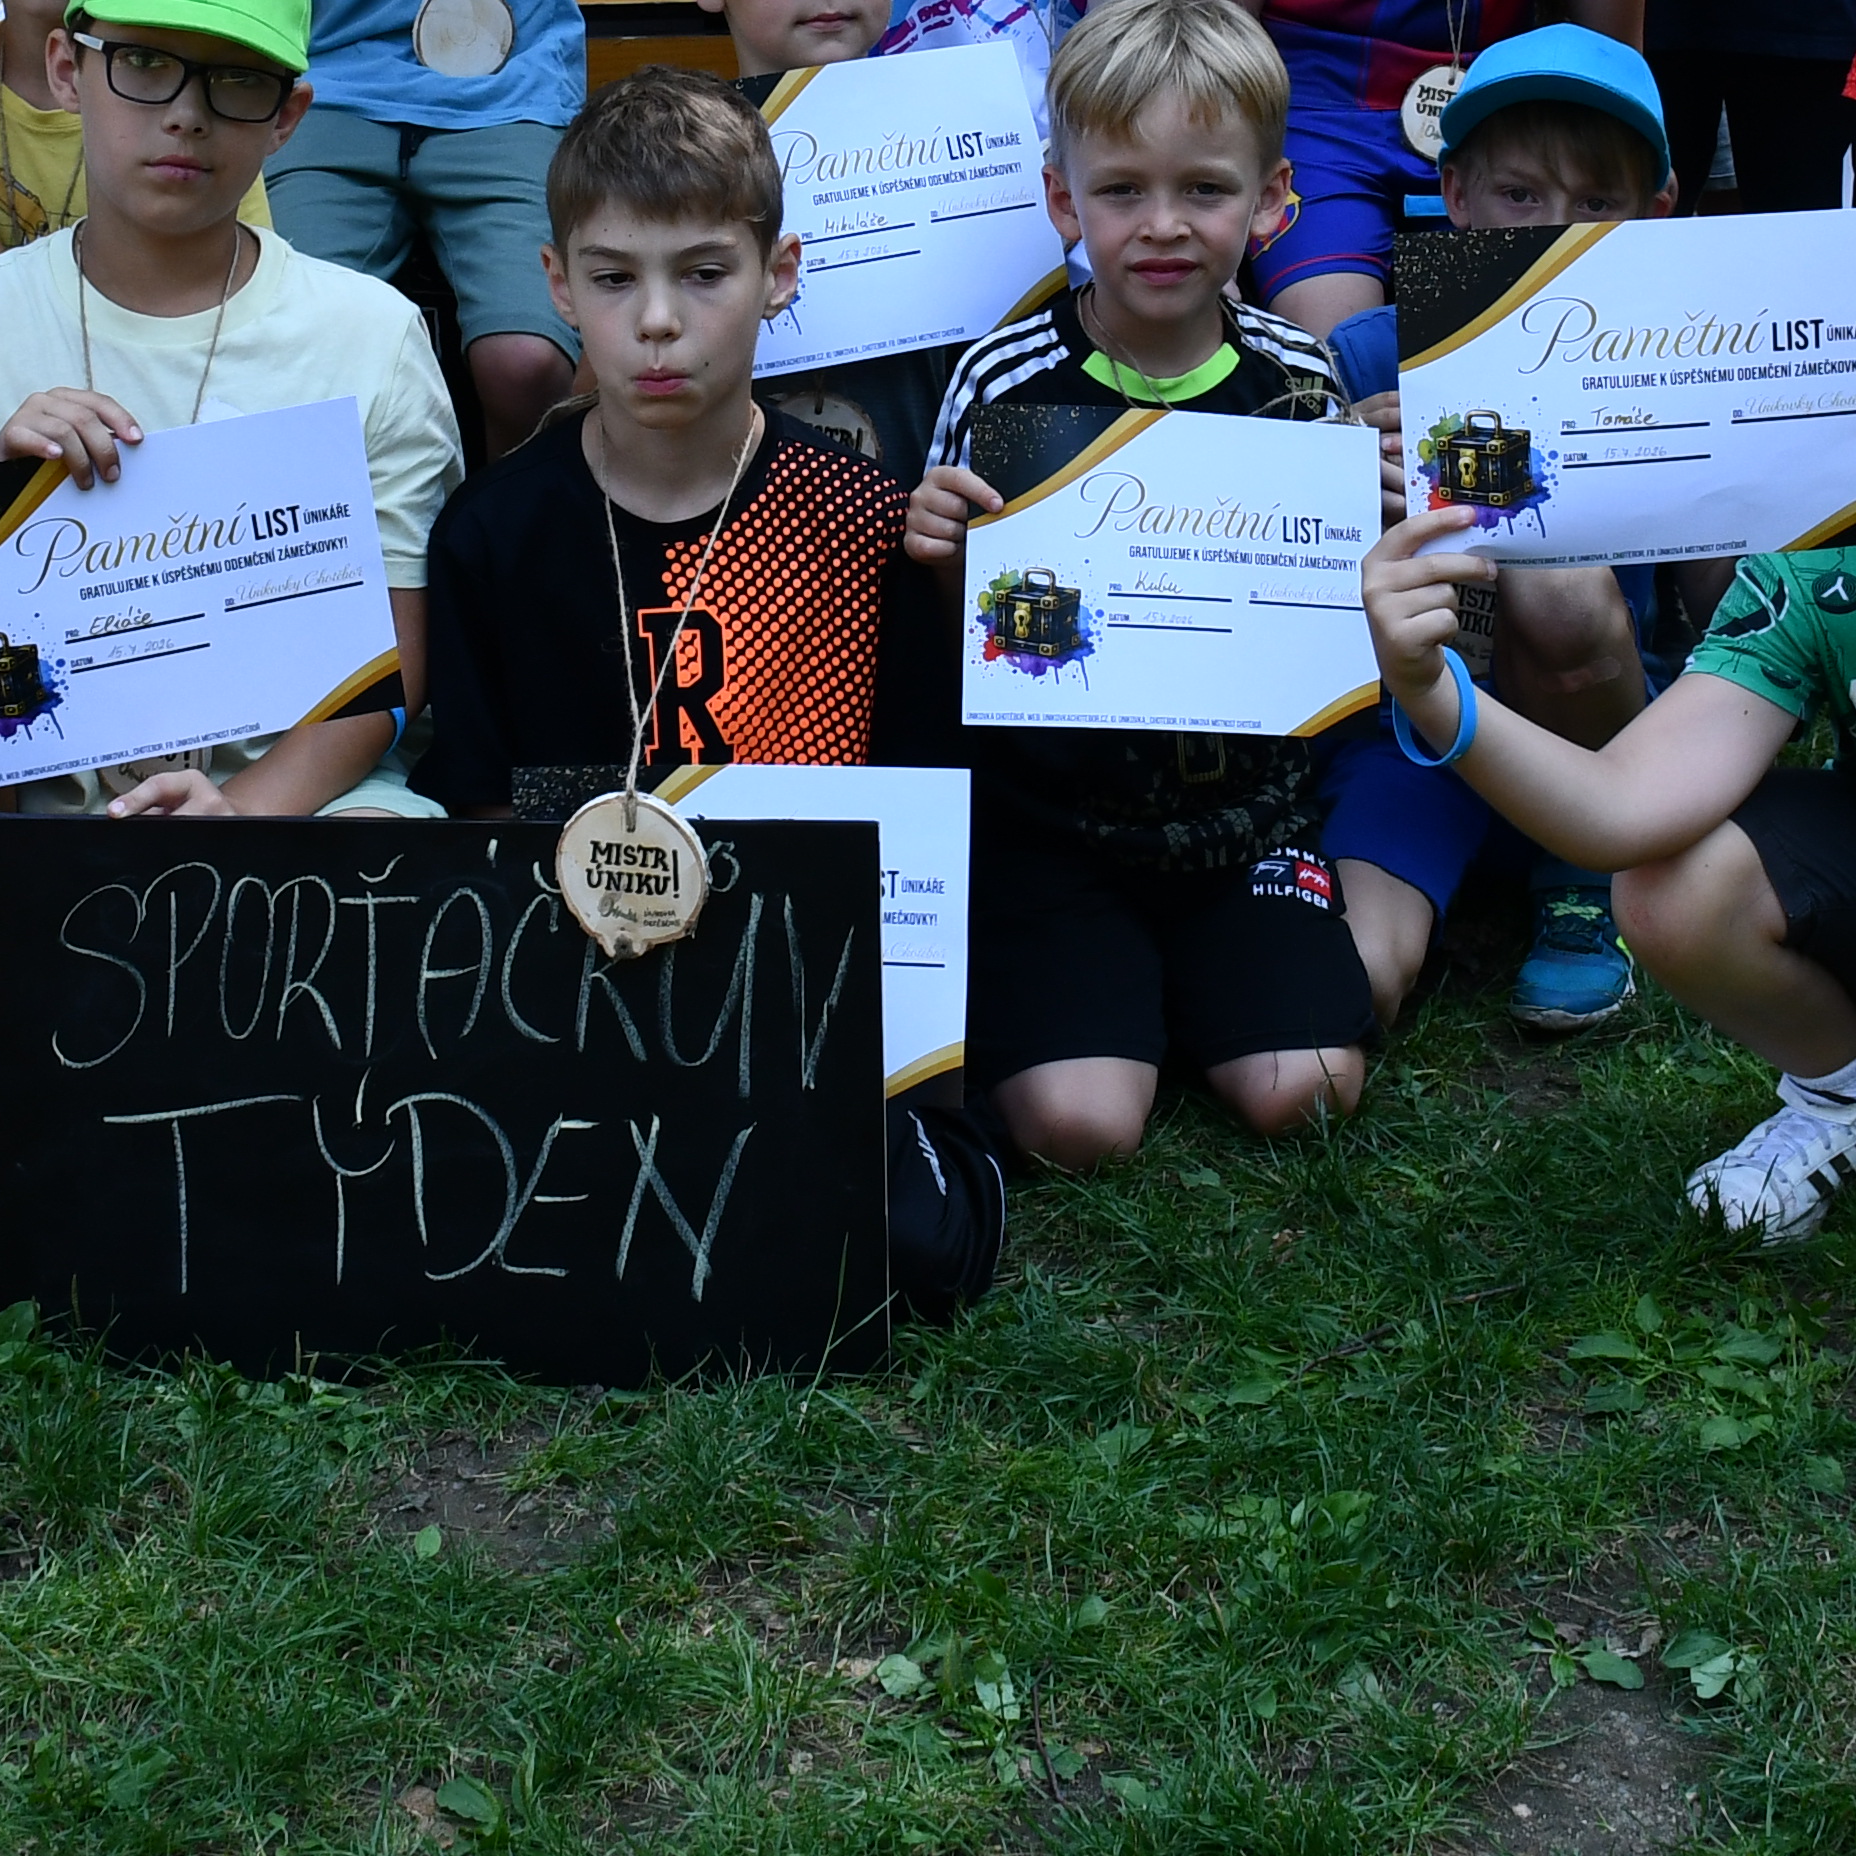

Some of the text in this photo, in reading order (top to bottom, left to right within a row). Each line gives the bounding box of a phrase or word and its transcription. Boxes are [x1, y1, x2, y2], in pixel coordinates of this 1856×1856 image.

[1417, 85, 1458, 103] MIST
[769, 125, 1021, 185] Pamětní LIST ÚNIKÁŘE
[811, 159, 1021, 206] GRATULUJEME K ÚSPĚŠNÉMU ODEMČENÍ ZÁMEČKOVKY!
[1517, 296, 1769, 375] Pamětní
[1771, 318, 1825, 352] LIST
[1581, 373, 1658, 391] GRATULUJEME
[1660, 372, 1668, 386] K
[1670, 366, 1735, 385] ÚSPĚŠNÉMU
[1738, 360, 1793, 382] ODEMČENÍ
[1590, 406, 1659, 427] Tomáše
[1074, 471, 1363, 545] Pamětní LIST ÚNIKÁŘE
[15, 501, 351, 595] Pamětní LIST ÚNIKÁŘE
[1128, 546, 1357, 573] GRATULUJEME K ÚSPĚŠNÉMU ODEMČENÍ ZÁMEČKOVKY!
[78, 534, 348, 602] GRATULUJEME K ÚSPĚŠNÉMU ODEMČENÍ ZÁMEČKOVKY!
[590, 840, 670, 872] MISTR
[901, 876, 946, 895] ÚNIKÁŘE
[1252, 883, 1329, 910] HILFIGER
[882, 907, 938, 927] MEČKOVKY!
[104, 1067, 757, 1302] TÝDEN
